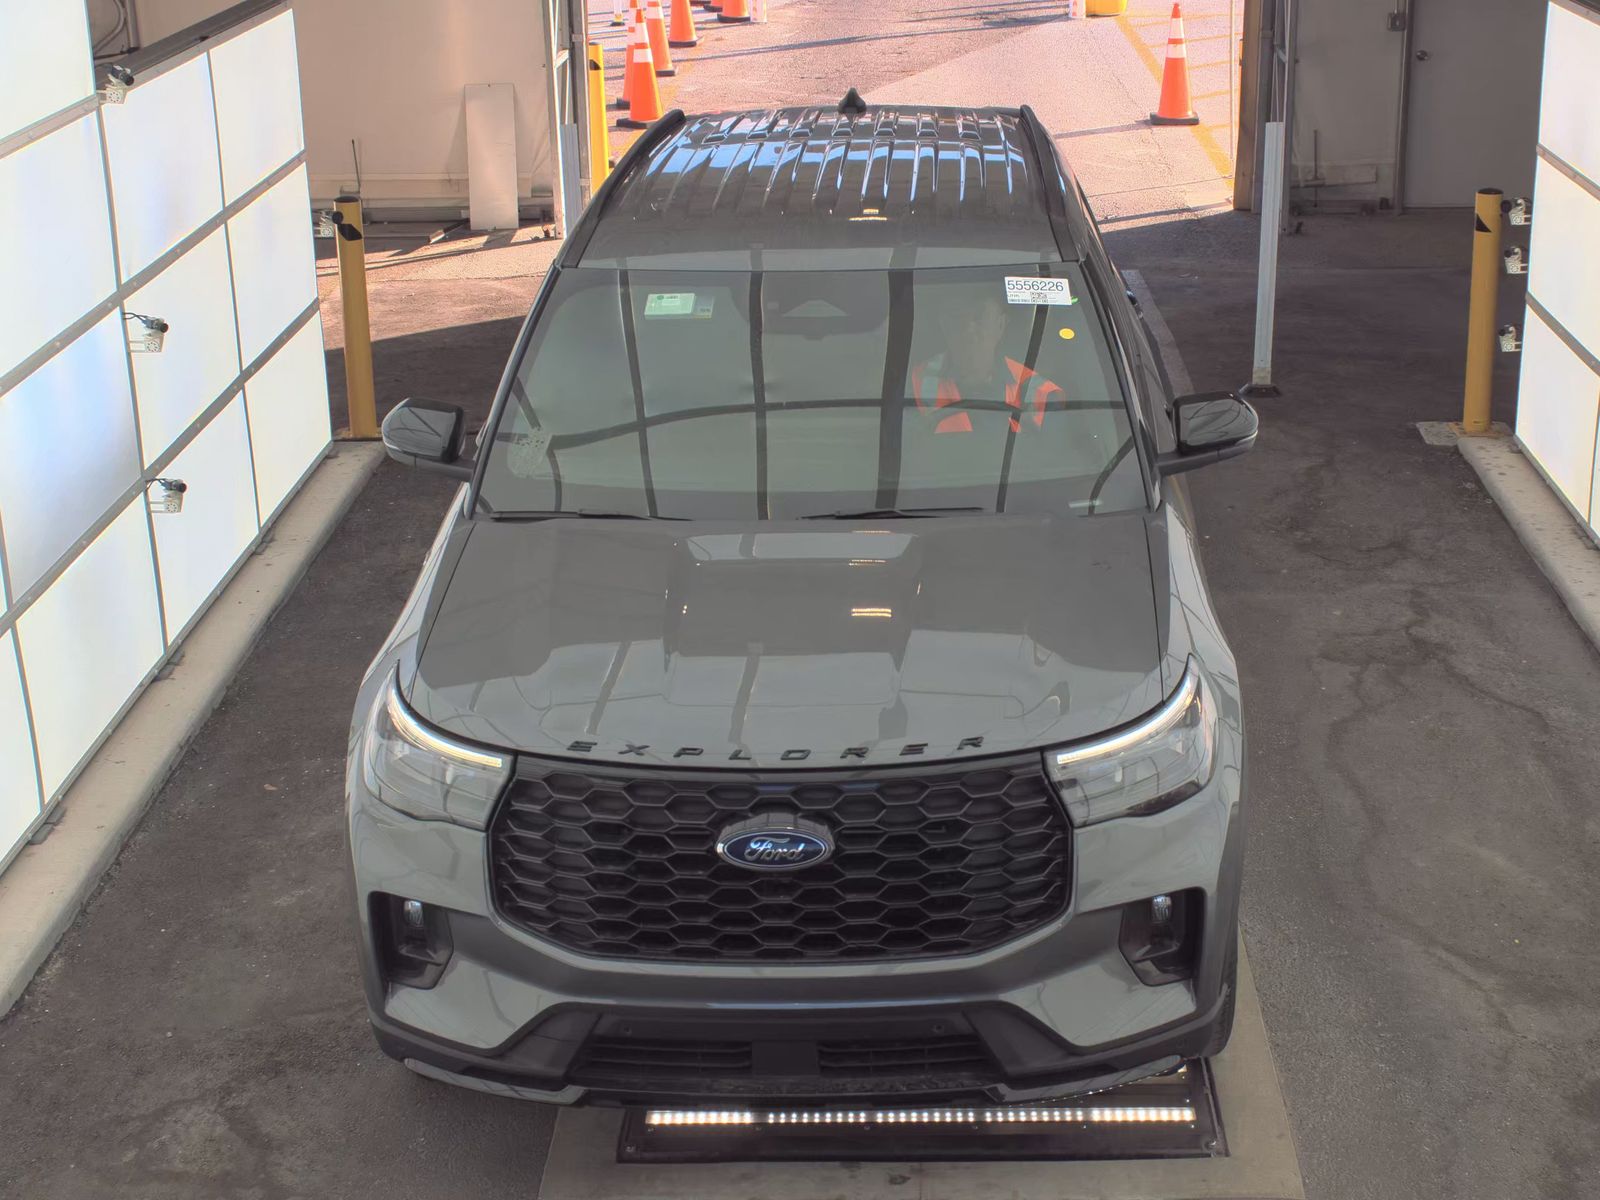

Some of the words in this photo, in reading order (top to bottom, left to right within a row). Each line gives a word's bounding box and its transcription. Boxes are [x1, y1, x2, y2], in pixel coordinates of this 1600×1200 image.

[1007, 280, 1064, 292] 5556226
[567, 736, 985, 761] EXPLORER
[744, 836, 805, 861] Ford
